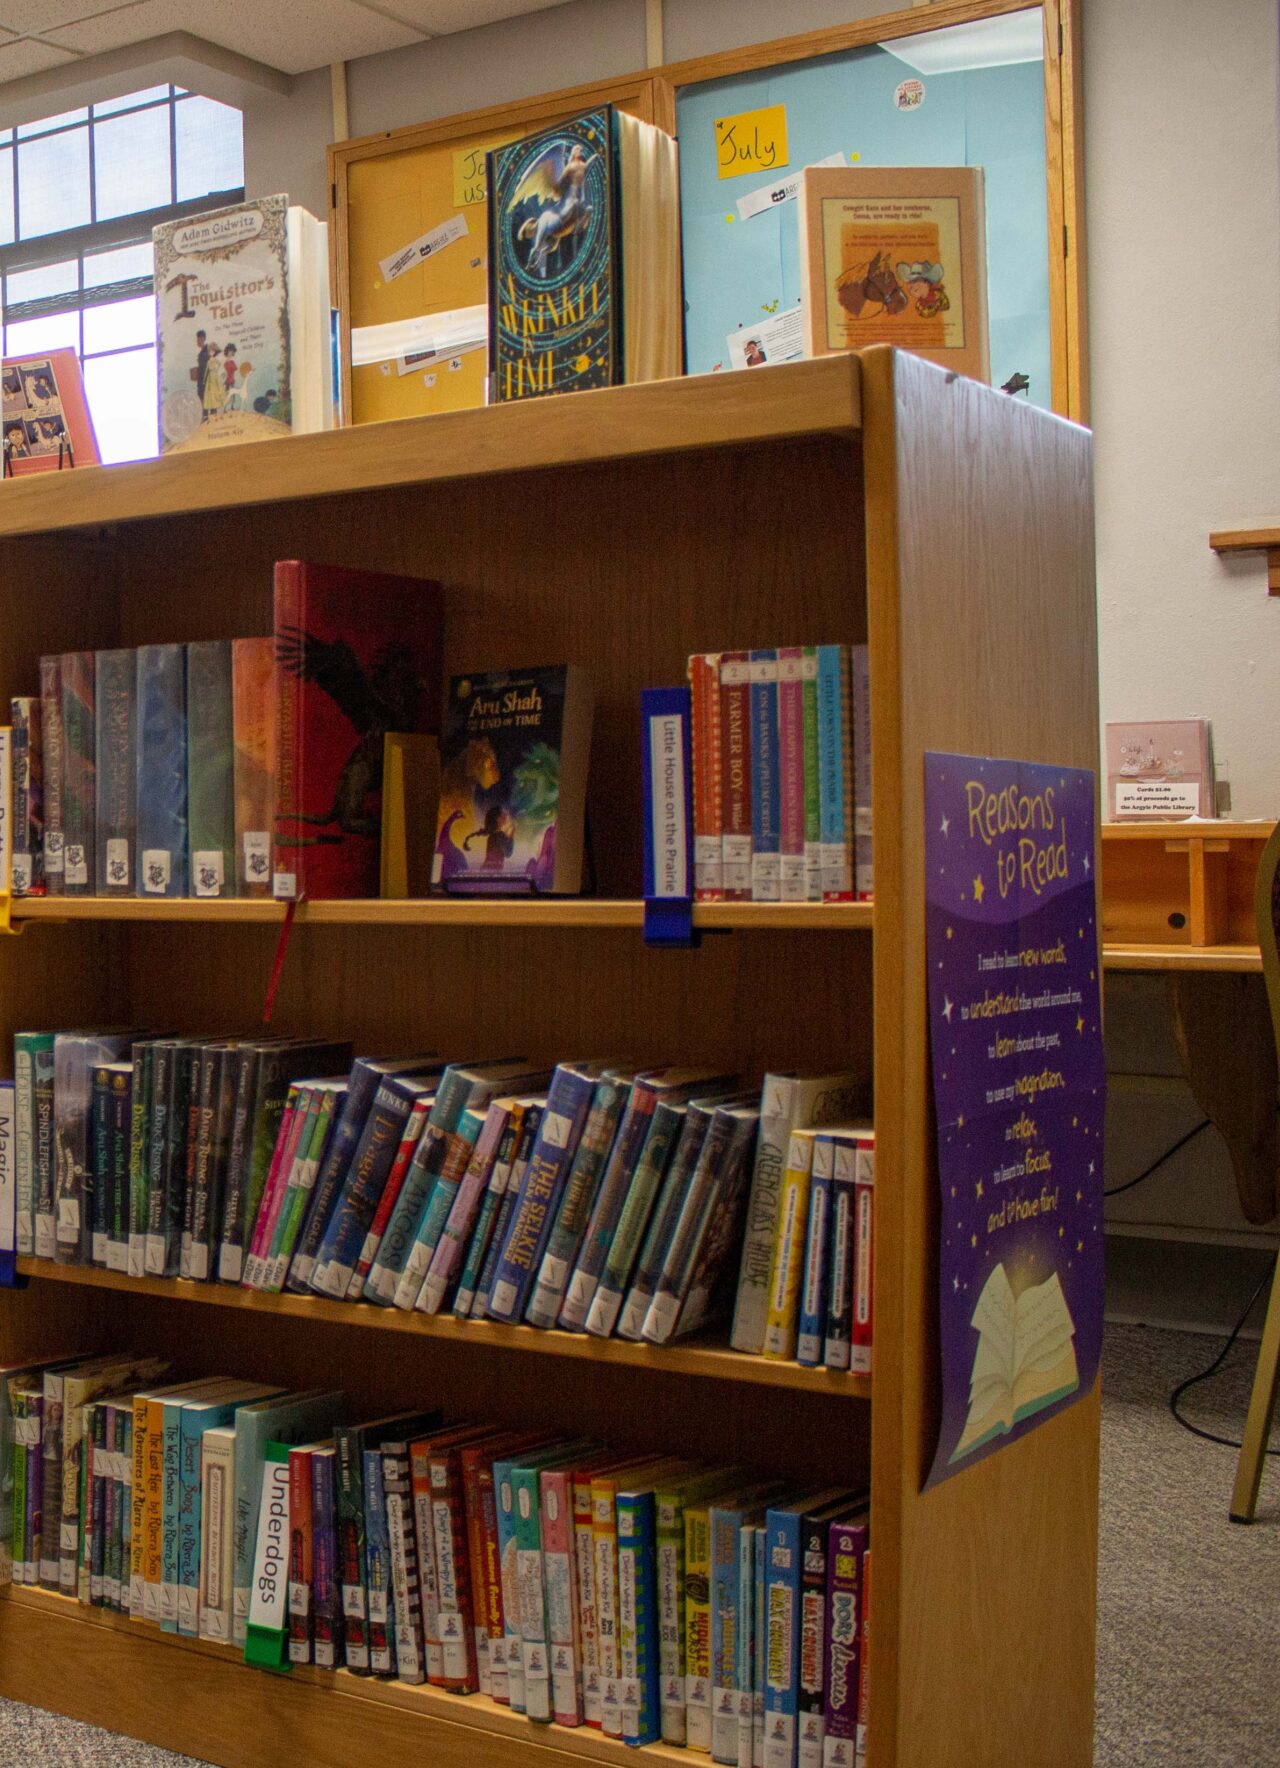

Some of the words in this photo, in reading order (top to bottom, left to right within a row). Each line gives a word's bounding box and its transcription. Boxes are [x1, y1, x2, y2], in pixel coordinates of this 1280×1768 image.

[720, 126, 776, 167] July
[464, 185, 485, 203] us
[181, 228, 210, 243] Adam
[212, 217, 254, 234] Gidwitz
[165, 274, 275, 321] Inquisitor's
[192, 282, 210, 293] The
[209, 303, 243, 320] Tale
[502, 282, 599, 337] WRINKLE
[506, 351, 553, 400] TIME
[470, 697, 501, 718] Aru
[502, 688, 543, 713] Shah
[786, 690, 796, 722] THESE
[516, 714, 541, 727] TIME
[663, 720, 675, 753] Little
[729, 691, 742, 754] FARMER
[760, 723, 769, 759] BANKS
[787, 724, 797, 759] HAPPY
[663, 757, 675, 796] House
[730, 760, 743, 792] BOY
[760, 770, 769, 799] PLUM
[826, 768, 836, 804] PRAIRIE
[664, 801, 674, 818] on
[761, 802, 771, 837] CREEK
[965, 780, 1055, 846] Reasons
[664, 821, 676, 846] the
[664, 849, 676, 893] Prairie
[997, 850, 1016, 898] to
[1018, 816, 1068, 895] Read
[983, 952, 997, 969] read
[1005, 949, 1019, 967] learn
[1020, 949, 1039, 967] new
[1040, 937, 1067, 964] words,
[961, 1005, 969, 1020] to
[970, 989, 1019, 1021] understand
[1019, 995, 1030, 1010] the
[1031, 993, 1050, 1009] world
[1051, 989, 1071, 1006] around
[988, 1044, 995, 1058] to
[995, 1030, 1016, 1059] learn
[1016, 1034, 1035, 1052] about
[1035, 1033, 1045, 1050] the
[17, 1066, 29, 1109] HOUSE
[986, 1089, 993, 1104] to
[1015, 1067, 1065, 1104] imagination,
[132, 1103, 144, 1136] DARK
[154, 1104, 166, 1137] DARK
[188, 1105, 200, 1138] DARK
[200, 1106, 213, 1140] DARK
[233, 1107, 247, 1140] DARK
[1012, 1111, 1038, 1140] relax,
[39, 1103, 50, 1176] SPINDLEFISH
[97, 1151, 108, 1175] Shah
[114, 1153, 125, 1177] Shah
[131, 1140, 144, 1176] RISING
[152, 1141, 164, 1181] RISING
[187, 1143, 198, 1181] RISING
[199, 1144, 211, 1184] RISING
[231, 1145, 244, 1185] RISING
[994, 1170, 1000, 1184] to
[1001, 1163, 1017, 1182] learn
[1025, 1148, 1052, 1176] focus,
[319, 1181, 334, 1210] THIEF
[524, 1170, 540, 1198] SAN
[535, 1162, 559, 1197] THE
[752, 1142, 783, 1234] GREENGLASS
[383, 1184, 426, 1267] ARGOS
[987, 1208, 1007, 1234] and
[1007, 1198, 1016, 1222] to
[1016, 1198, 1039, 1222] have
[1040, 1186, 1059, 1214] fun!
[309, 1217, 322, 1244] LORD
[503, 1200, 530, 1262] FRANCISCO
[513, 1203, 546, 1269] SELKIE
[134, 1407, 146, 1422] The
[149, 1432, 162, 1448] The
[166, 1424, 179, 1441] The
[134, 1426, 145, 1479] Adventures
[149, 1449, 162, 1471] Lost
[164, 1444, 179, 1464] Way
[182, 1436, 203, 1474] Desert
[134, 1482, 145, 1493] of
[149, 1473, 161, 1493] Heir
[164, 1466, 177, 1506] Between
[180, 1479, 202, 1514] Song
[148, 1501, 160, 1513] by
[163, 1514, 176, 1526] by
[437, 1508, 449, 1534] Diary
[148, 1516, 161, 1550] Rivera
[164, 1529, 177, 1559] Rivera
[181, 1524, 192, 1535] by
[258, 1465, 289, 1605] Underdogs
[810, 1537, 820, 1550] 2
[840, 1536, 852, 1551] 2
[132, 1546, 144, 1573] Rivera
[147, 1552, 161, 1576] Sun
[183, 1537, 195, 1569] Rivera
[440, 1552, 451, 1581] Wimpy
[487, 1541, 497, 1582] Awesome
[164, 1561, 177, 1582] Sun
[443, 1583, 453, 1598] Kid
[489, 1585, 500, 1625] Friendly
[770, 1588, 784, 1618] MAX
[803, 1596, 815, 1624] MAX
[836, 1596, 853, 1639] DORK
[697, 1612, 710, 1662] MIDDLE
[802, 1627, 816, 1687] CRUMBLY
[830, 1646, 854, 1708] diaries
